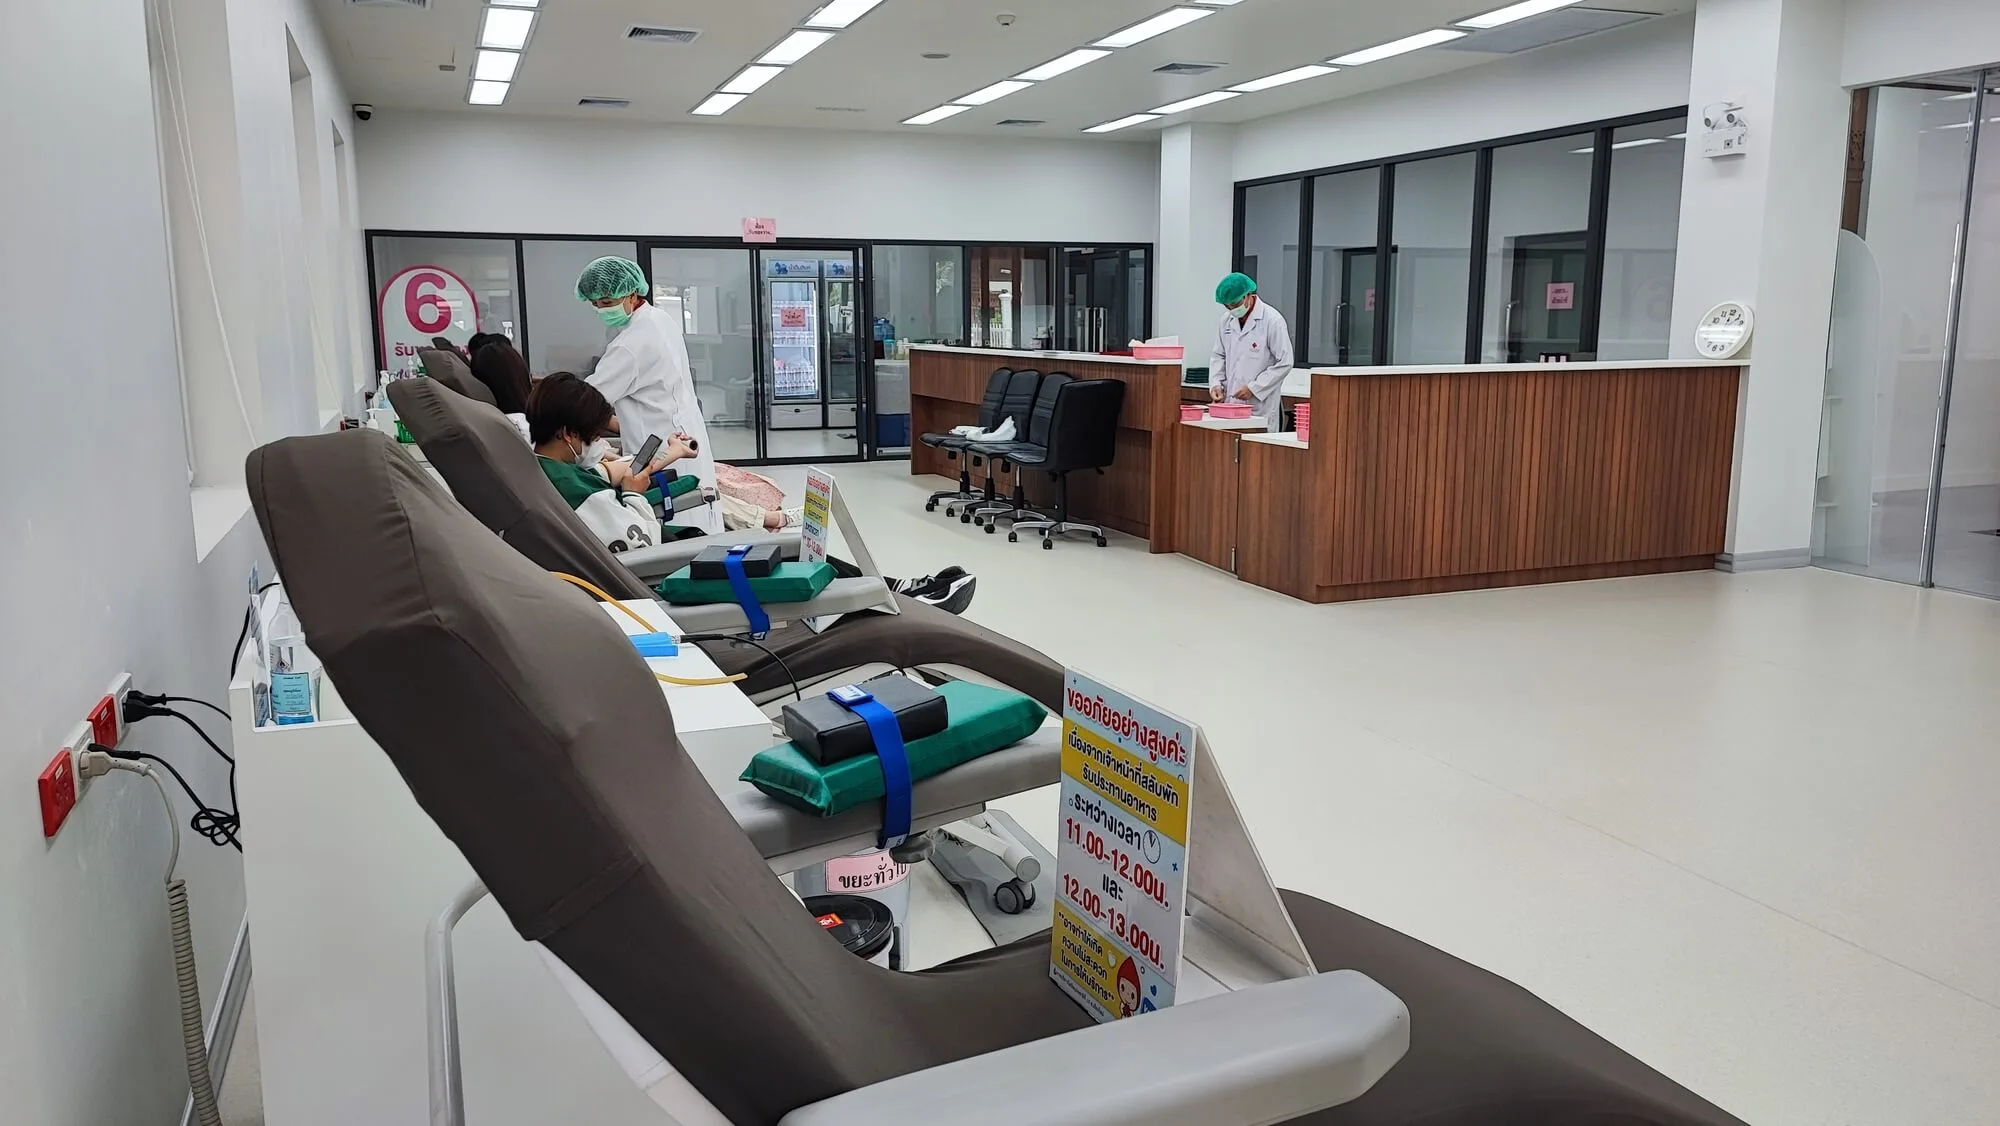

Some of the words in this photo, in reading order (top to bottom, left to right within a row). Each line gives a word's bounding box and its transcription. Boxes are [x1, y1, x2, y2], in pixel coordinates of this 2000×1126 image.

[405, 272, 452, 333] 6
[1067, 687, 1187, 764] ขออภัยอย่างสูงค่ะ
[1067, 727, 1179, 807] เนื่องจากเจ้าหน้าที่สลับพัก
[1082, 764, 1158, 822] รับประทานอาหาร
[1074, 793, 1142, 851] ระหว่างเวลา
[1066, 817, 1170, 908] 11.00-12.00น.
[1102, 873, 1124, 902] และ
[1063, 873, 1165, 970] 12.00-13.00น.
[1062, 935, 1108, 981] ความไม่สะดวก
